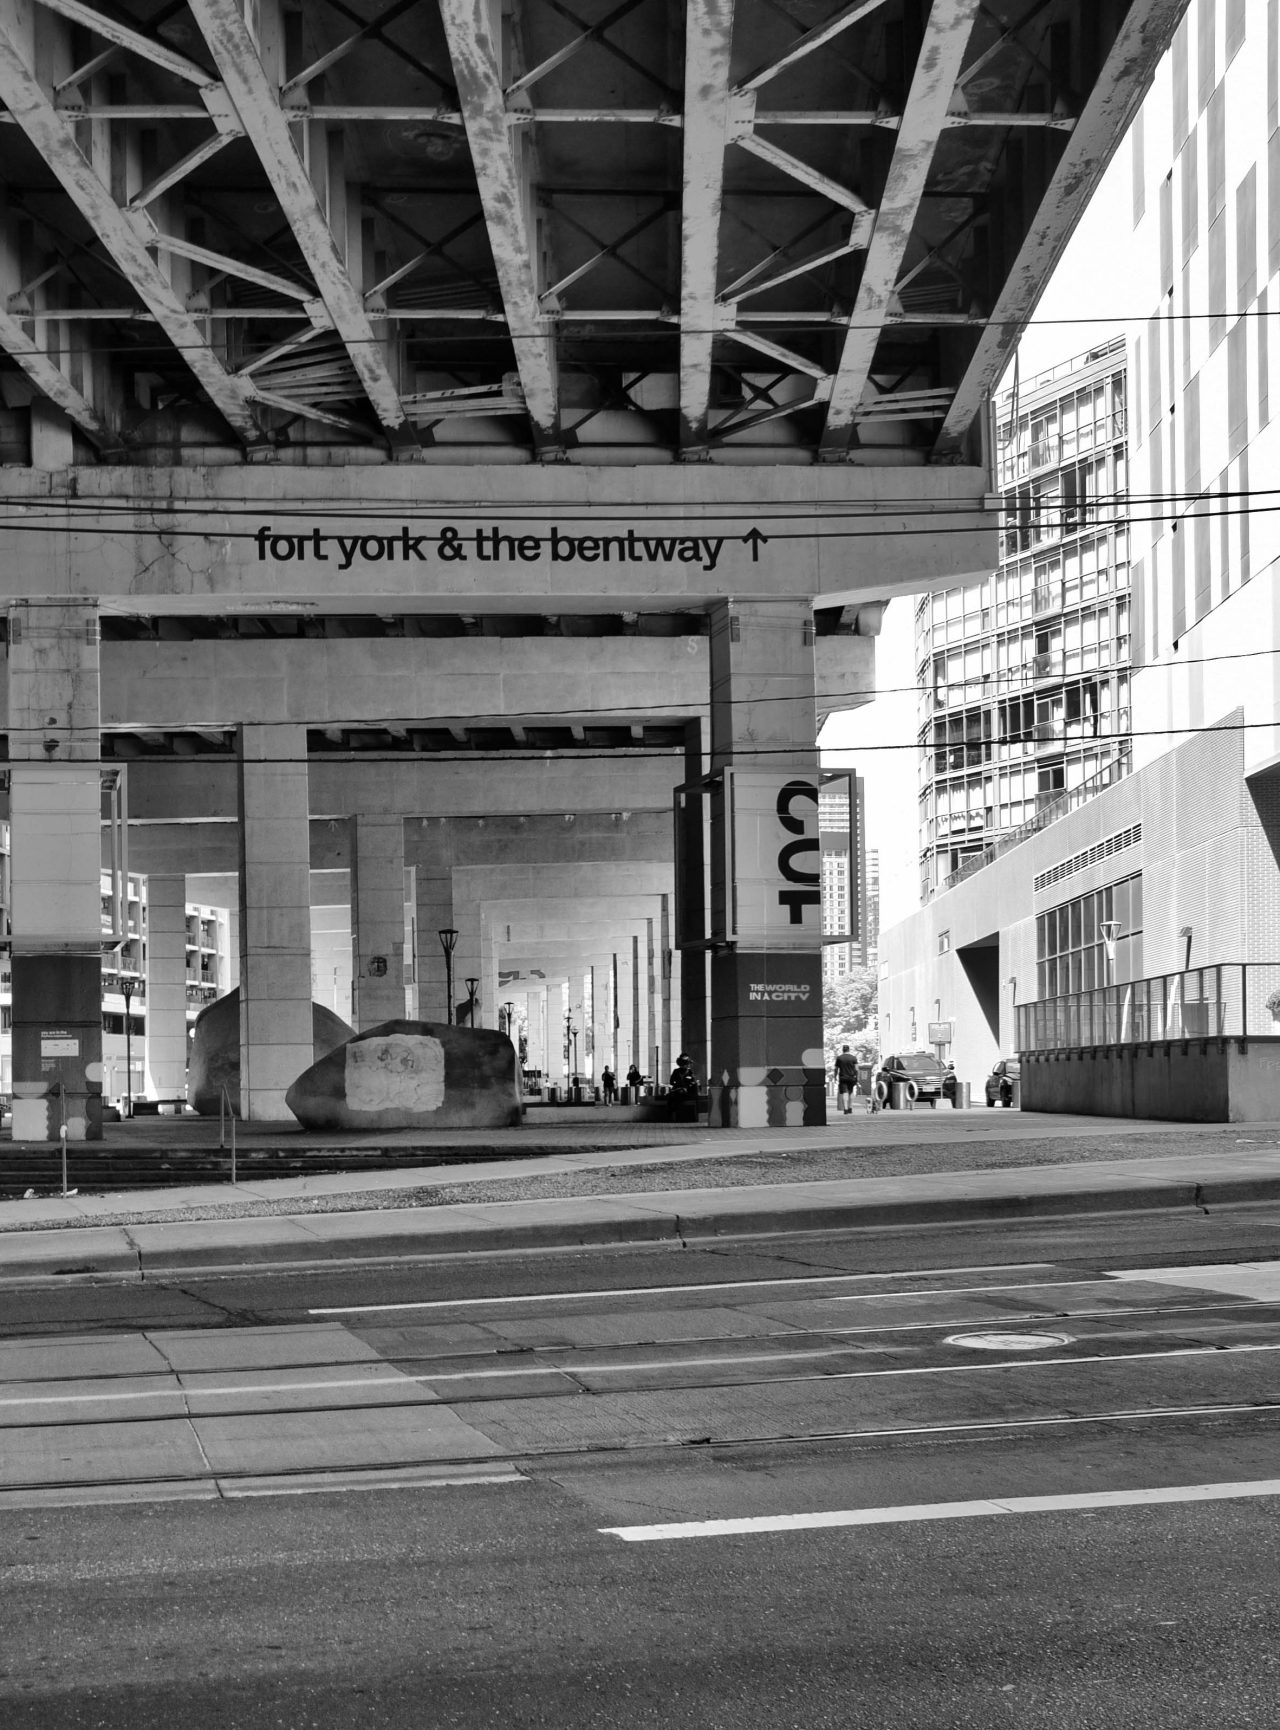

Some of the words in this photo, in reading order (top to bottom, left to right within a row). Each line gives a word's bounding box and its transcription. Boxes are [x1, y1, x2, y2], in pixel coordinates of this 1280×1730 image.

[256, 526, 328, 560] fort
[337, 525, 426, 570] york
[437, 527, 467, 561] &
[476, 526, 541, 562] the
[552, 527, 724, 571] bentway
[749, 983, 765, 991] THE
[765, 984, 810, 992] WORLD
[749, 992, 761, 1000] IN
[762, 992, 770, 1001] A
[771, 992, 810, 1001] CITY
